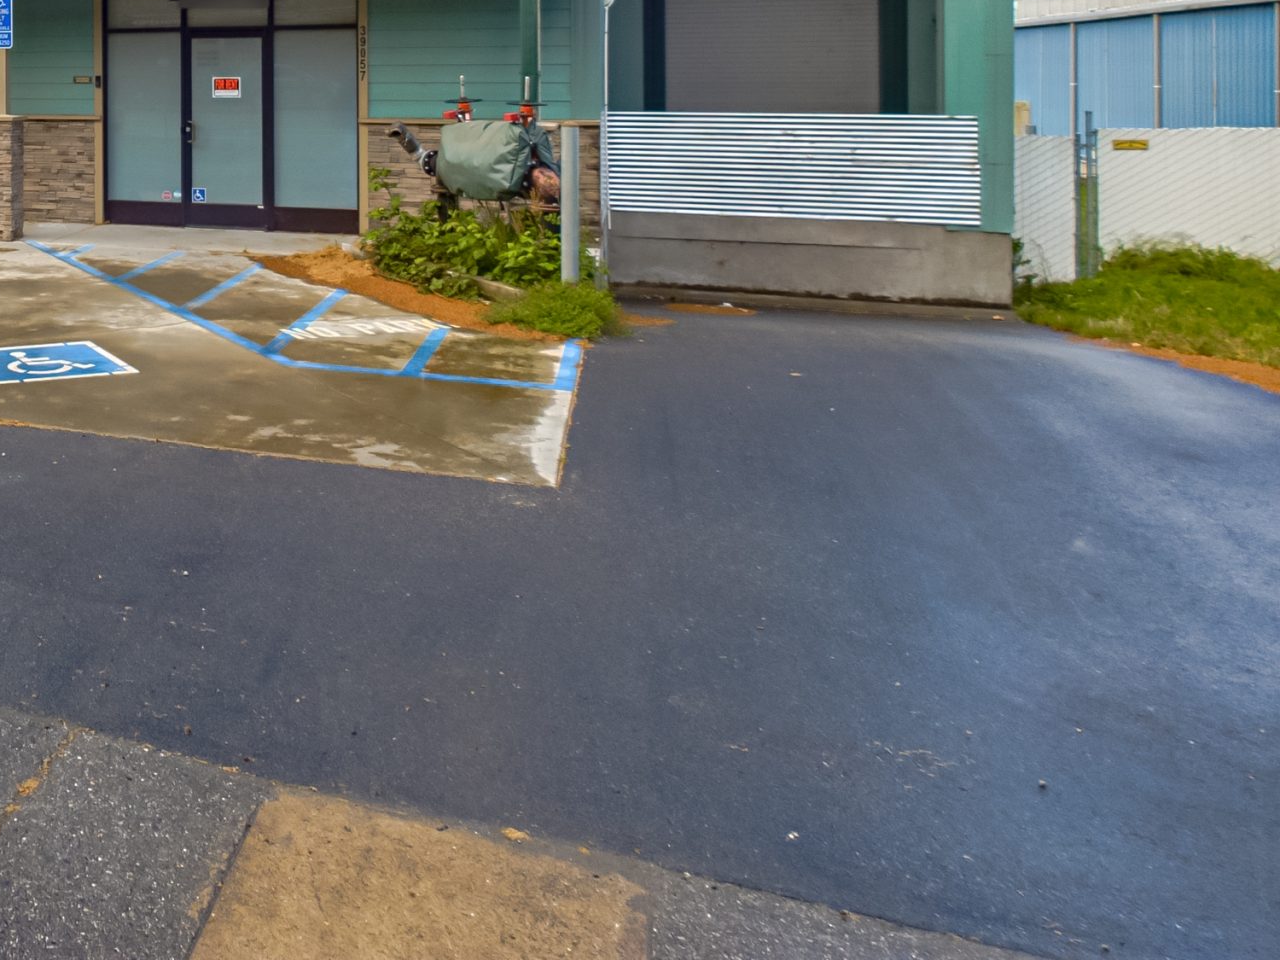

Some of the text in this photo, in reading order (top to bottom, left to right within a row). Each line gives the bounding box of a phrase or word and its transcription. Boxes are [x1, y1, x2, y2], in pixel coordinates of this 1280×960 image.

[359, 25, 367, 82] 39057
[214, 79, 239, 90] FOR RENT
[279, 326, 341, 339] NO
